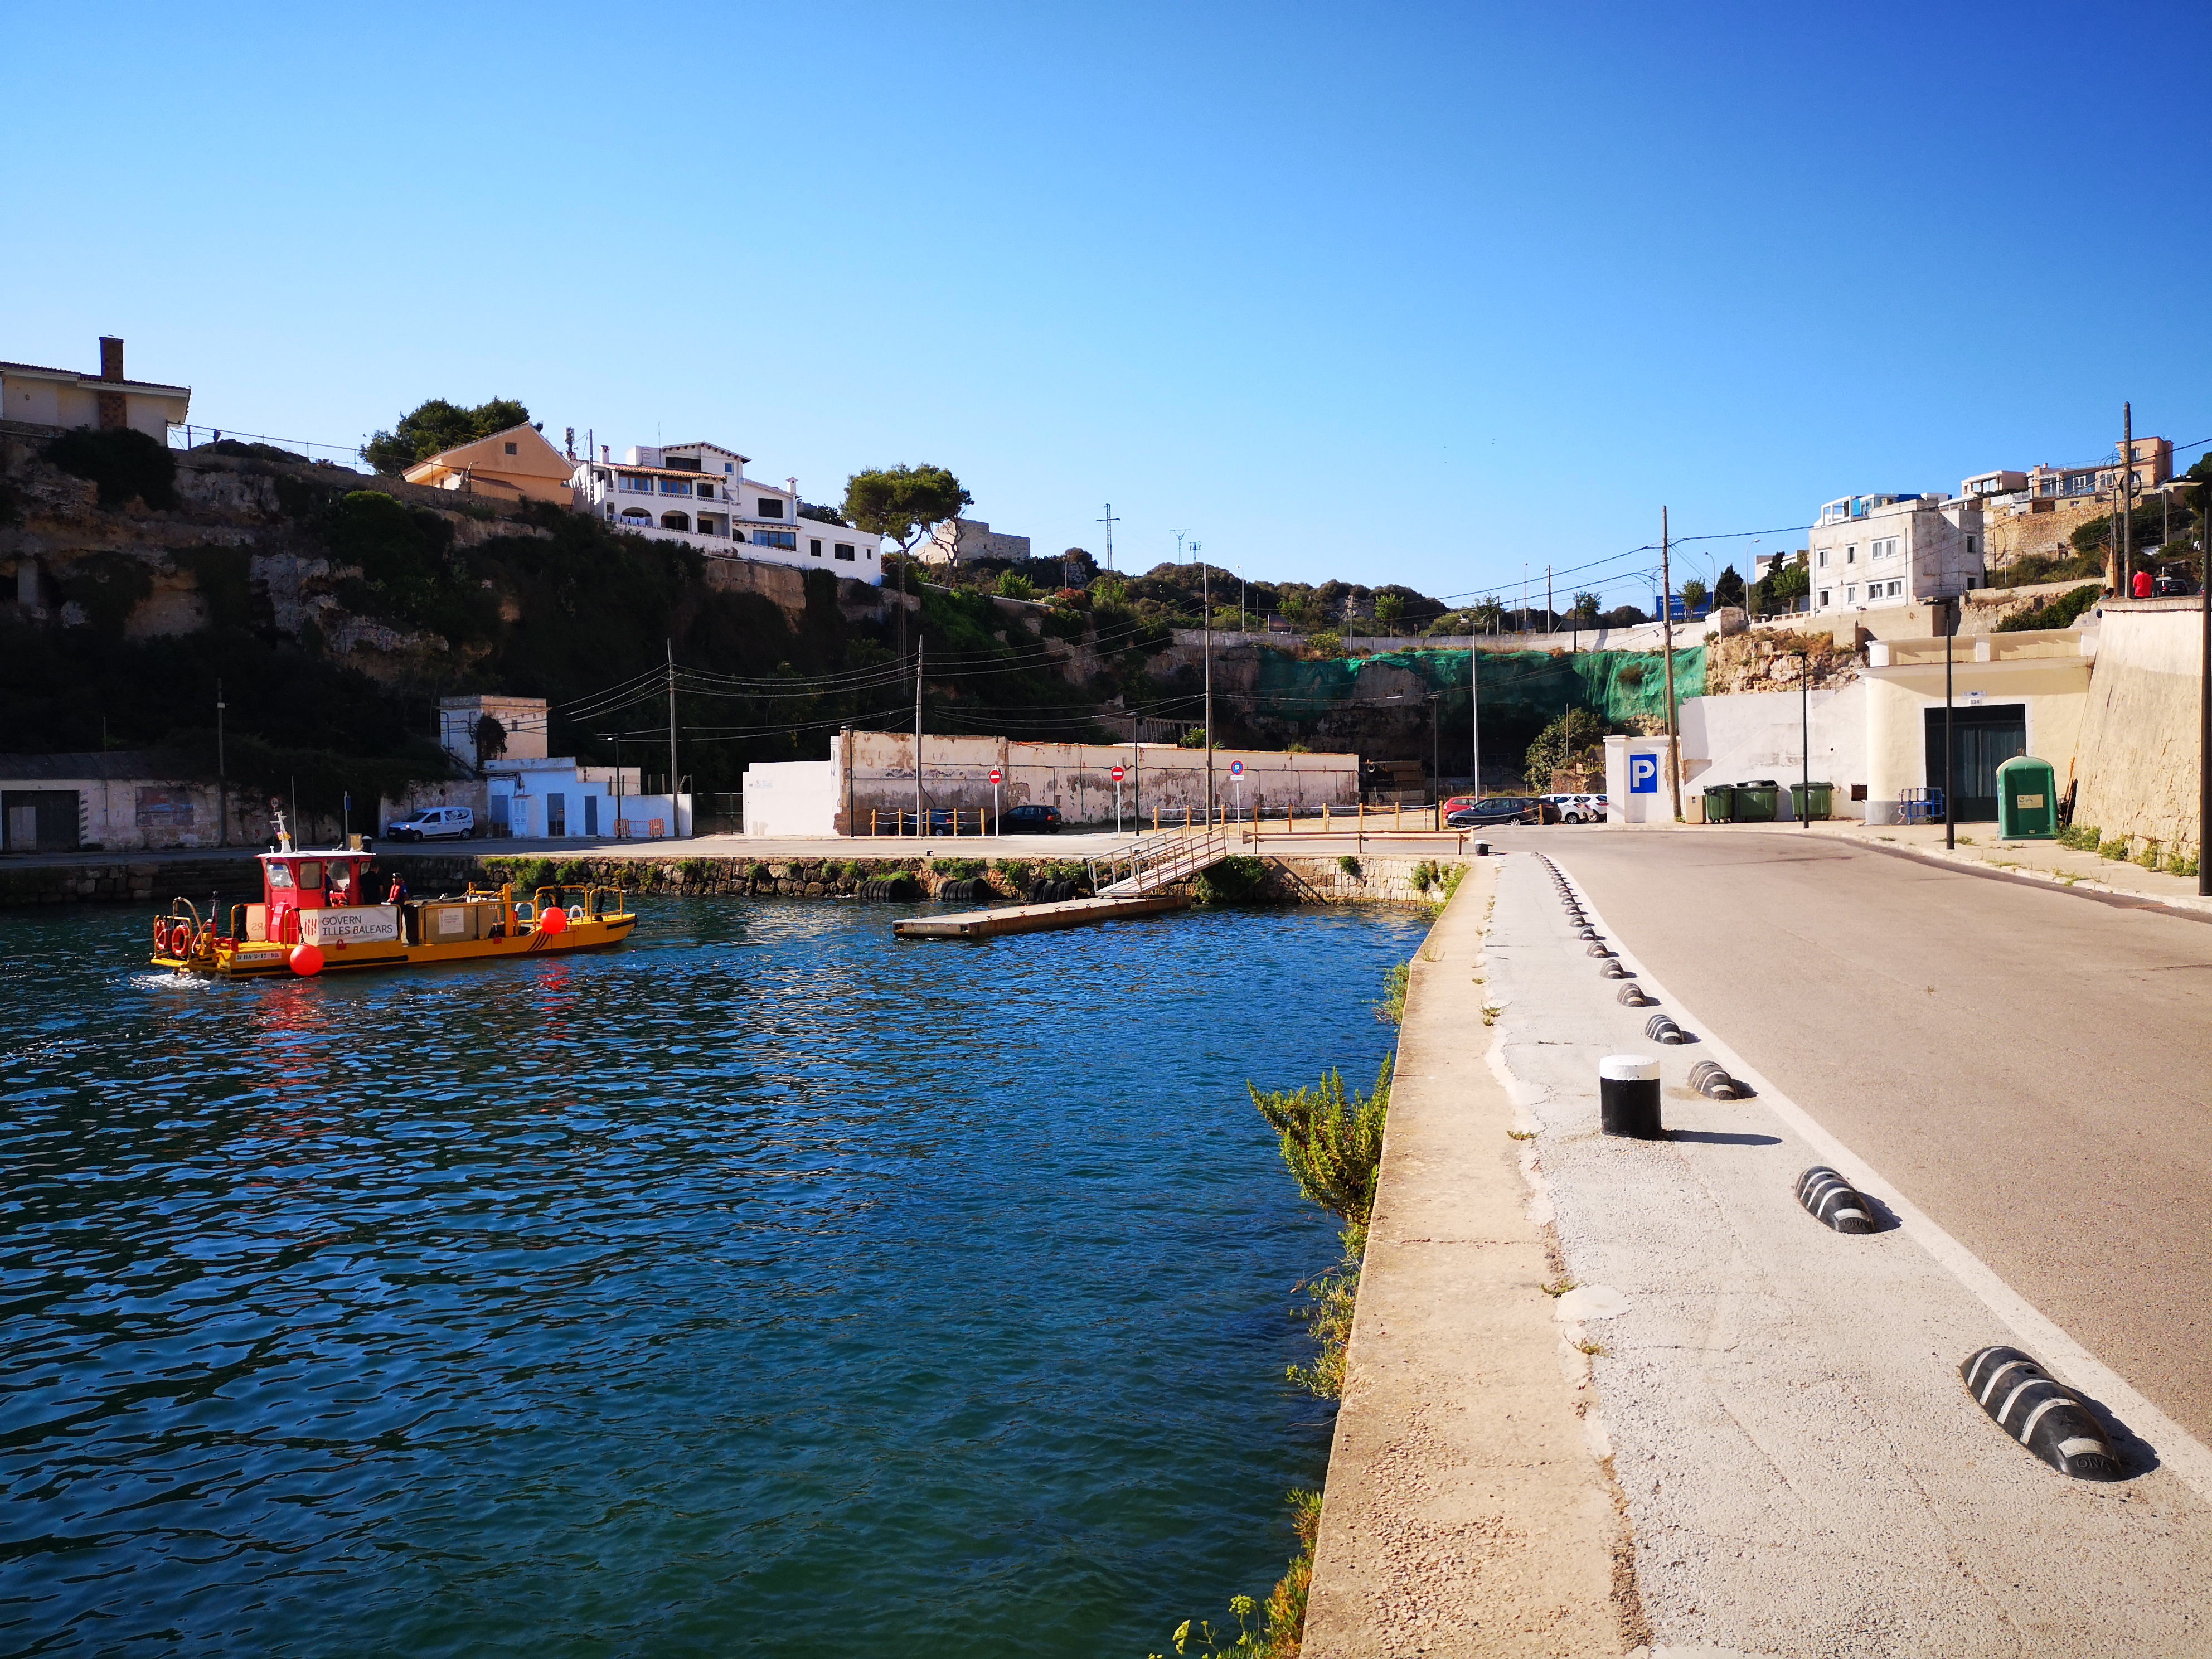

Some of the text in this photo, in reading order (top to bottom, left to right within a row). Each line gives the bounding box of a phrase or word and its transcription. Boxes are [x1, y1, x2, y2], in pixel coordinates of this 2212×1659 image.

[1632, 760, 1655, 788] P
[322, 915, 361, 925] GOVERN
[322, 924, 393, 936] ILLES BALEARS
[1844, 1219, 1866, 1228] ONA
[2077, 1456, 2111, 1472] ONA
